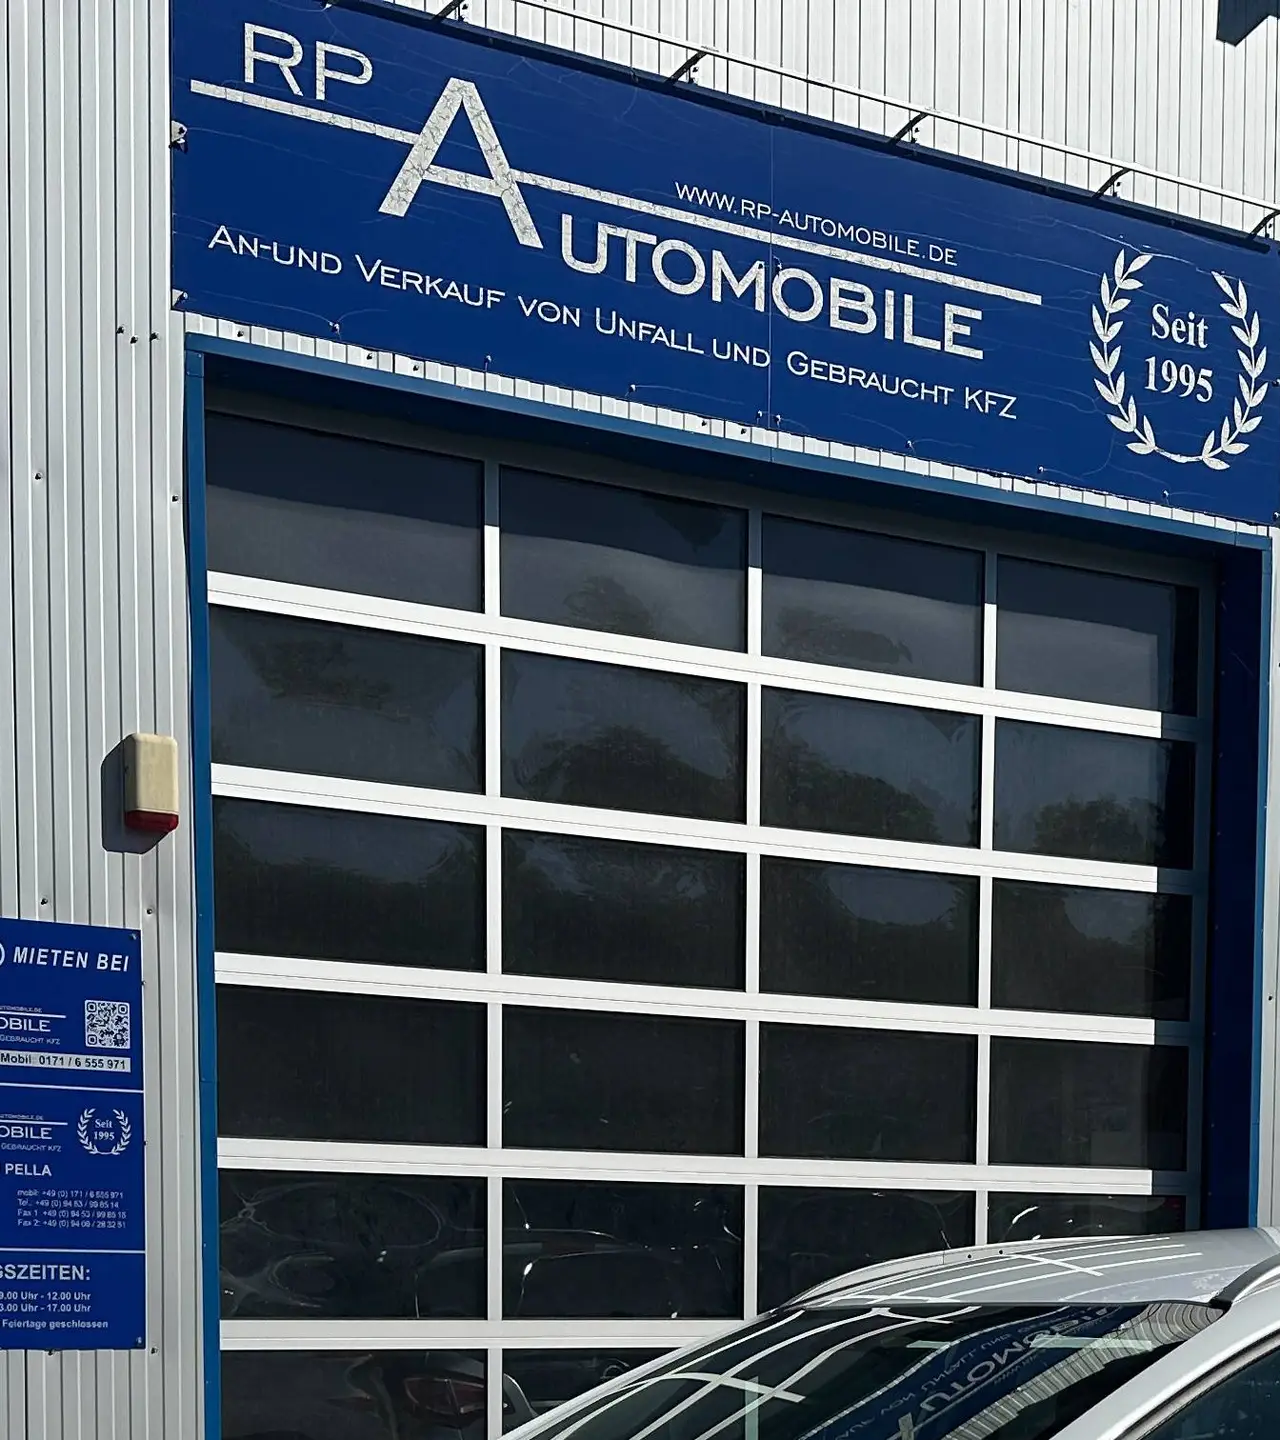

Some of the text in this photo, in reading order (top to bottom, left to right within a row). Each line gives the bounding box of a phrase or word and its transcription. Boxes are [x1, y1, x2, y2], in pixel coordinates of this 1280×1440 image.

[244, 22, 373, 100] RP
[378, 77, 984, 360] AUTOMOBILE
[674, 181, 958, 267] WWW.RP-AUTOMOBILE.DE
[1151, 302, 1211, 349] Seit
[355, 254, 505, 308] VERKAUF
[518, 295, 581, 327] VON
[595, 308, 704, 356] UNFALL
[712, 338, 771, 368] UND
[786, 351, 955, 406] GEBRAUCHT
[964, 386, 1018, 420] KFZ
[1144, 355, 1215, 403] 1995
[13, 946, 89, 968] MIETEN
[96, 954, 130, 972] BEI
[39, 1055, 64, 1066] 0171
[75, 1057, 81, 1067] 6
[85, 1058, 104, 1069] 555
[107, 1059, 126, 1069] 971
[95, 1118, 113, 1129] Seit
[93, 1131, 115, 1141] 1995
[5, 1163, 53, 1177] PELLA
[20, 1291, 38, 1300] Uhr
[46, 1291, 72, 1301] 12.00
[74, 1292, 91, 1301] Uhr
[20, 1303, 38, 1312] Uhr
[46, 1303, 71, 1312] 17.00
[74, 1303, 91, 1312] Uhr
[2, 1319, 47, 1330] Feiertage
[49, 1319, 108, 1330] geschlossen
